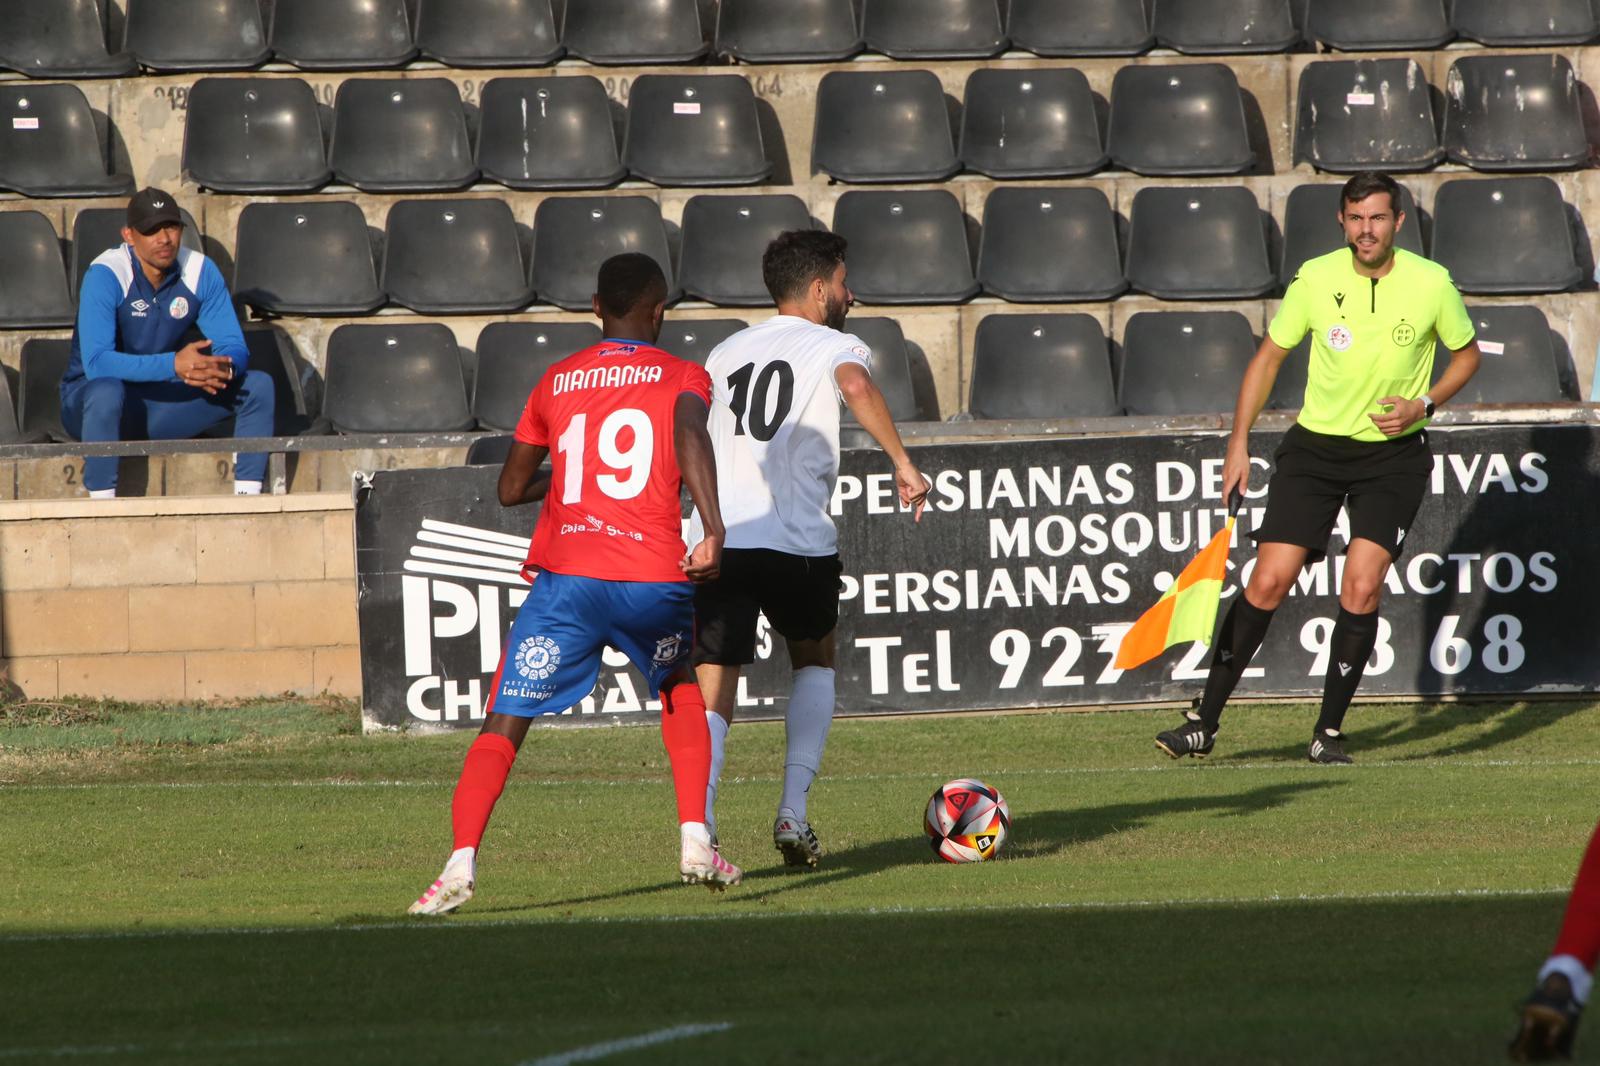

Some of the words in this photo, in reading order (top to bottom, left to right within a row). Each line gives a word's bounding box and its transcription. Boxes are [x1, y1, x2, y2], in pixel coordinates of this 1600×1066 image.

[553, 365, 662, 396] DIAMANKA
[727, 359, 794, 441] 10
[558, 408, 654, 505] 19
[830, 463, 1135, 516] PERSIANAS
[1156, 452, 1549, 502] DECIVAS
[838, 562, 1131, 614] PERSIANAS
[989, 625, 1136, 688] 927
[1430, 614, 1525, 675] 68
[503, 685, 518, 697] Los
